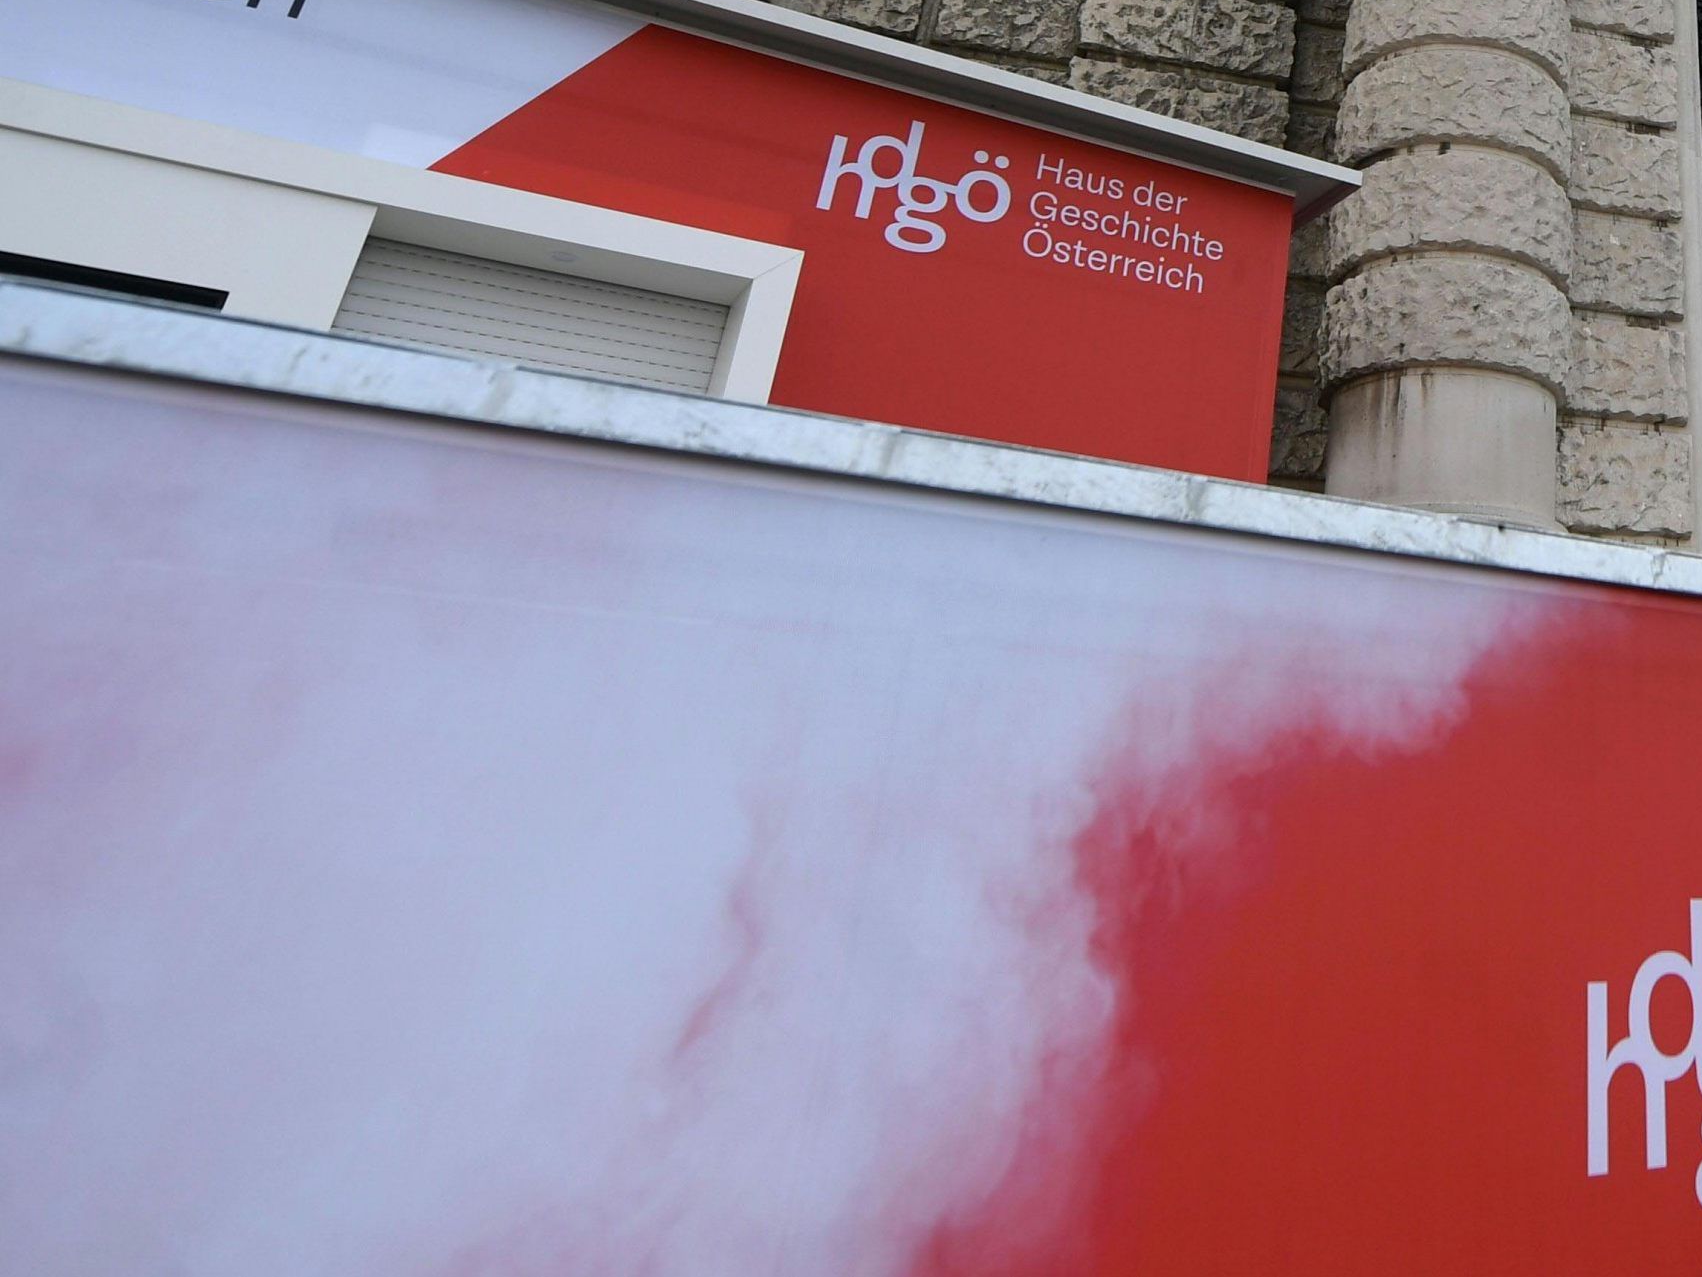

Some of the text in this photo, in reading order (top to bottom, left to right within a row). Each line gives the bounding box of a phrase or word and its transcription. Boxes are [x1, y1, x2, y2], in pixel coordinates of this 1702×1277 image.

[816, 120, 1011, 253] hdgö
[1036, 153, 1188, 216] Haus der
[1023, 221, 1205, 293] Österreich
[1030, 191, 1224, 261] Geschichte
